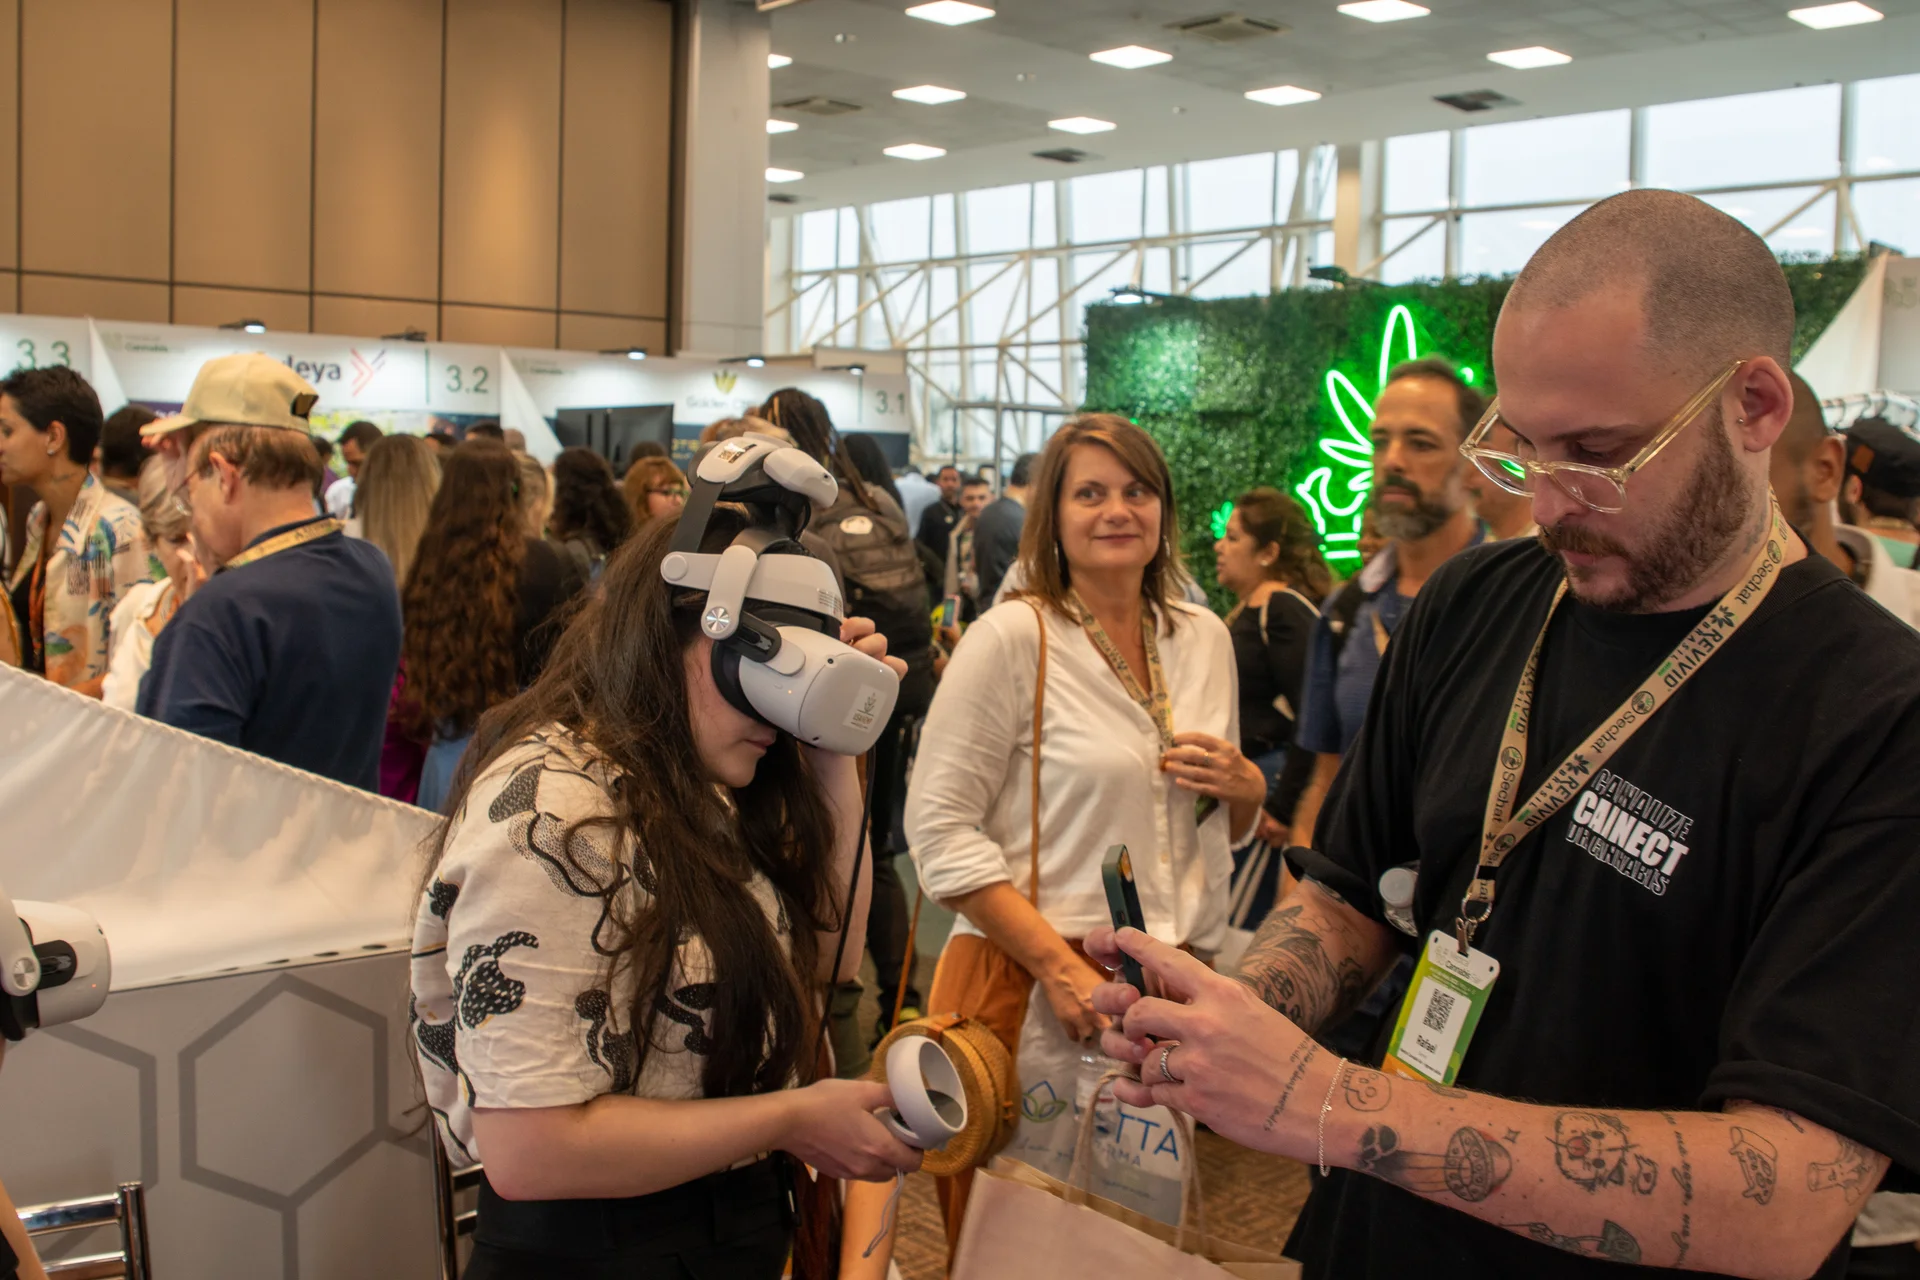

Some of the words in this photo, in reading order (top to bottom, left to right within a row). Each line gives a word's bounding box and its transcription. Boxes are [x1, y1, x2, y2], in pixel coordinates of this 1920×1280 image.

[17, 338, 71, 371] 33
[446, 364, 489, 394] 3.2
[875, 390, 906, 415] 3.1
[1735, 559, 1774, 605] Sechat
[1663, 628, 1724, 689] REVIVID
[1670, 621, 1711, 661] BRASIL
[1590, 710, 1637, 753] Sechat
[1491, 771, 1516, 822] Sechat
[1523, 776, 1580, 828] REVIVID
[1529, 769, 1566, 808] BRASIL
[1416, 1034, 1437, 1055] Rafael
